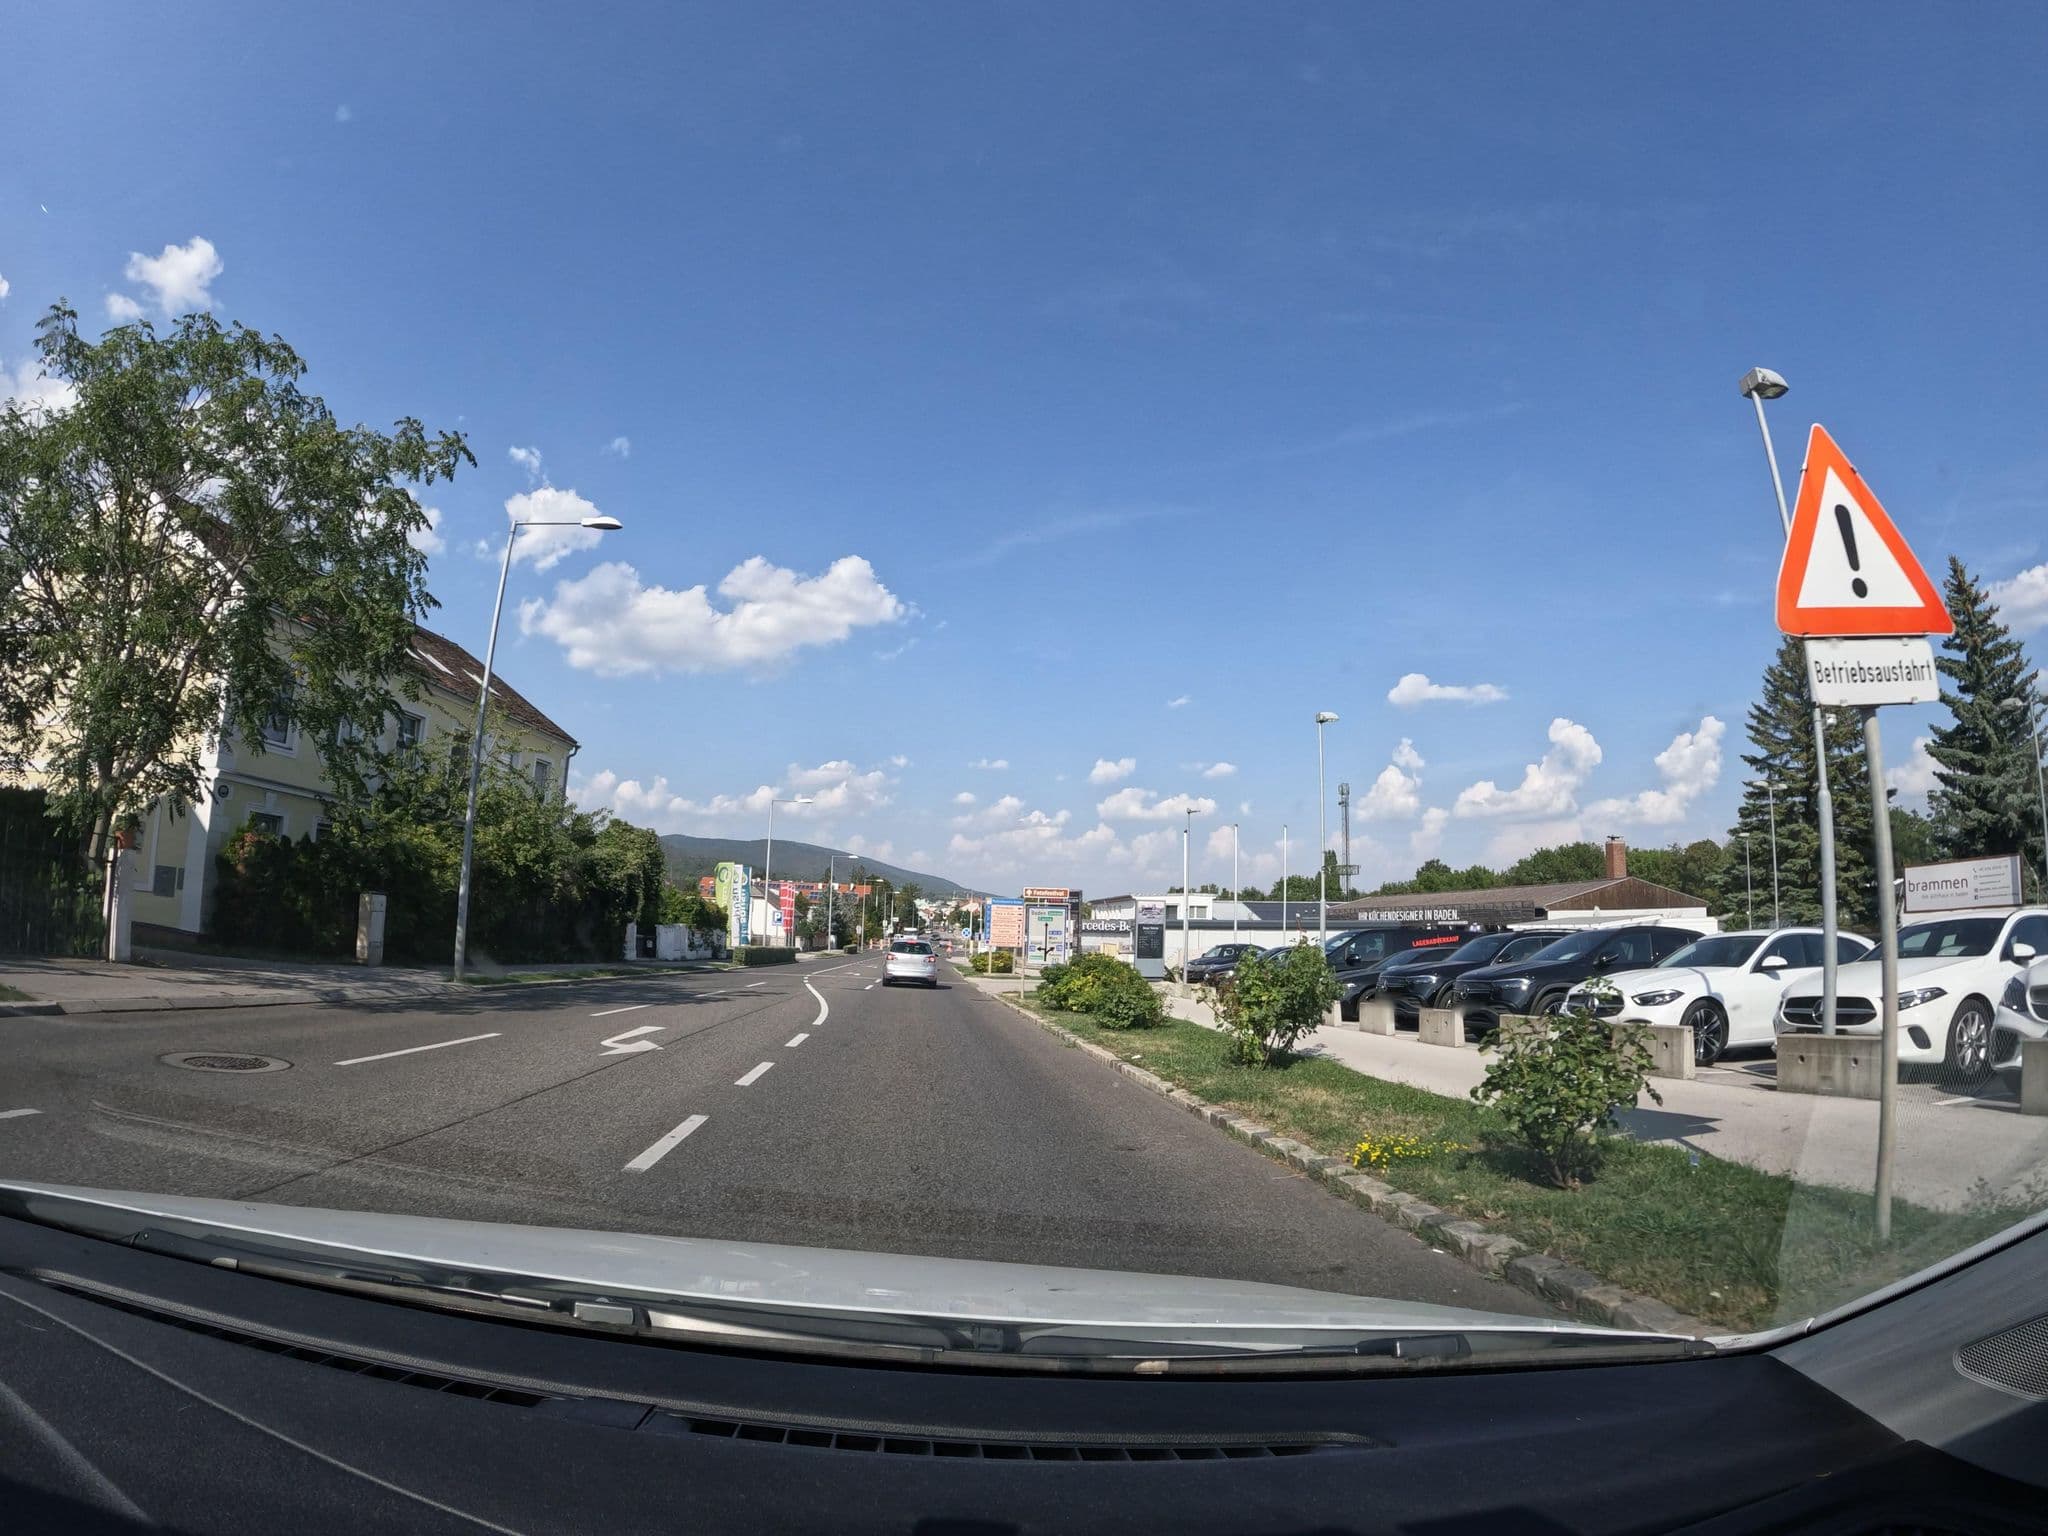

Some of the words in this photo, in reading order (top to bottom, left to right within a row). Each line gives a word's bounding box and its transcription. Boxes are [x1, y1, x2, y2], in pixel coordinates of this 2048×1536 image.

[1814, 659, 1933, 683] Betriebsausfahrt
[1908, 878, 1968, 892] brammen
[1368, 909, 1425, 921] KÜCHENDESIGNER
[1425, 909, 1432, 920] IN
[1433, 908, 1460, 920] BADEN.
[1082, 920, 1131, 931] rcedes-Be
